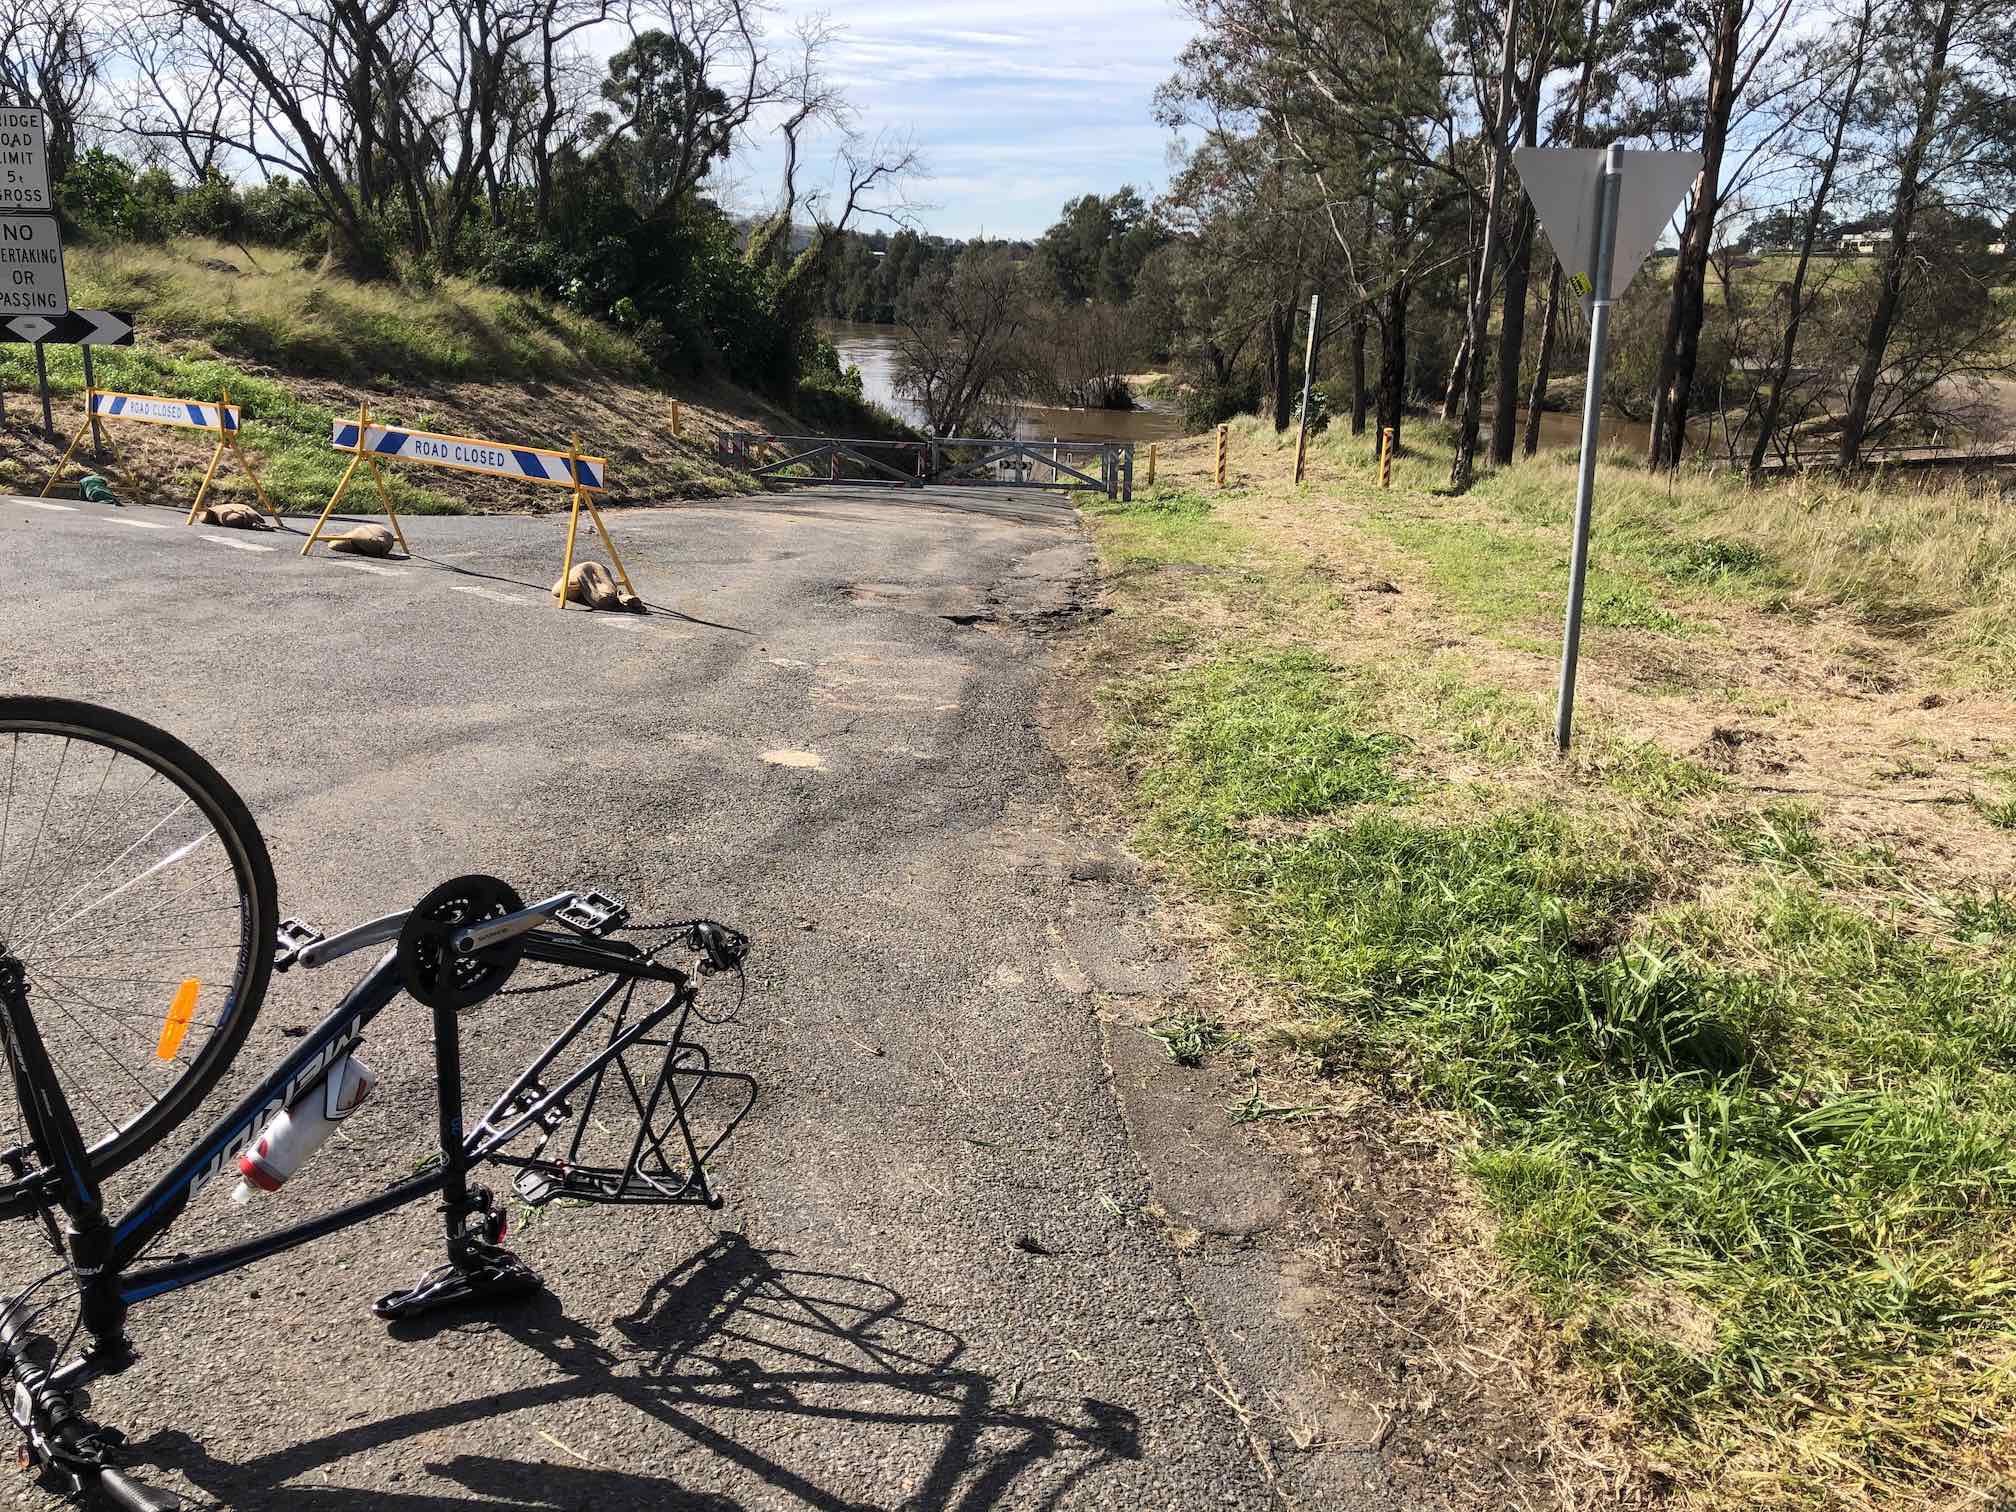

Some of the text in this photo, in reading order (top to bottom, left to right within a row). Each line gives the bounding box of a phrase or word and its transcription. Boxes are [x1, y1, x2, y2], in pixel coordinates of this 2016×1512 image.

[0, 114, 39, 128] IDGE
[1, 133, 32, 146] OAD
[0, 152, 33, 165] IMIT
[3, 223, 33, 241] NO
[1, 247, 57, 264] ERTAKING
[12, 270, 34, 285] OR
[130, 401, 182, 419] ROAD CLOSED
[415, 440, 505, 467] ROAD CLOSED
